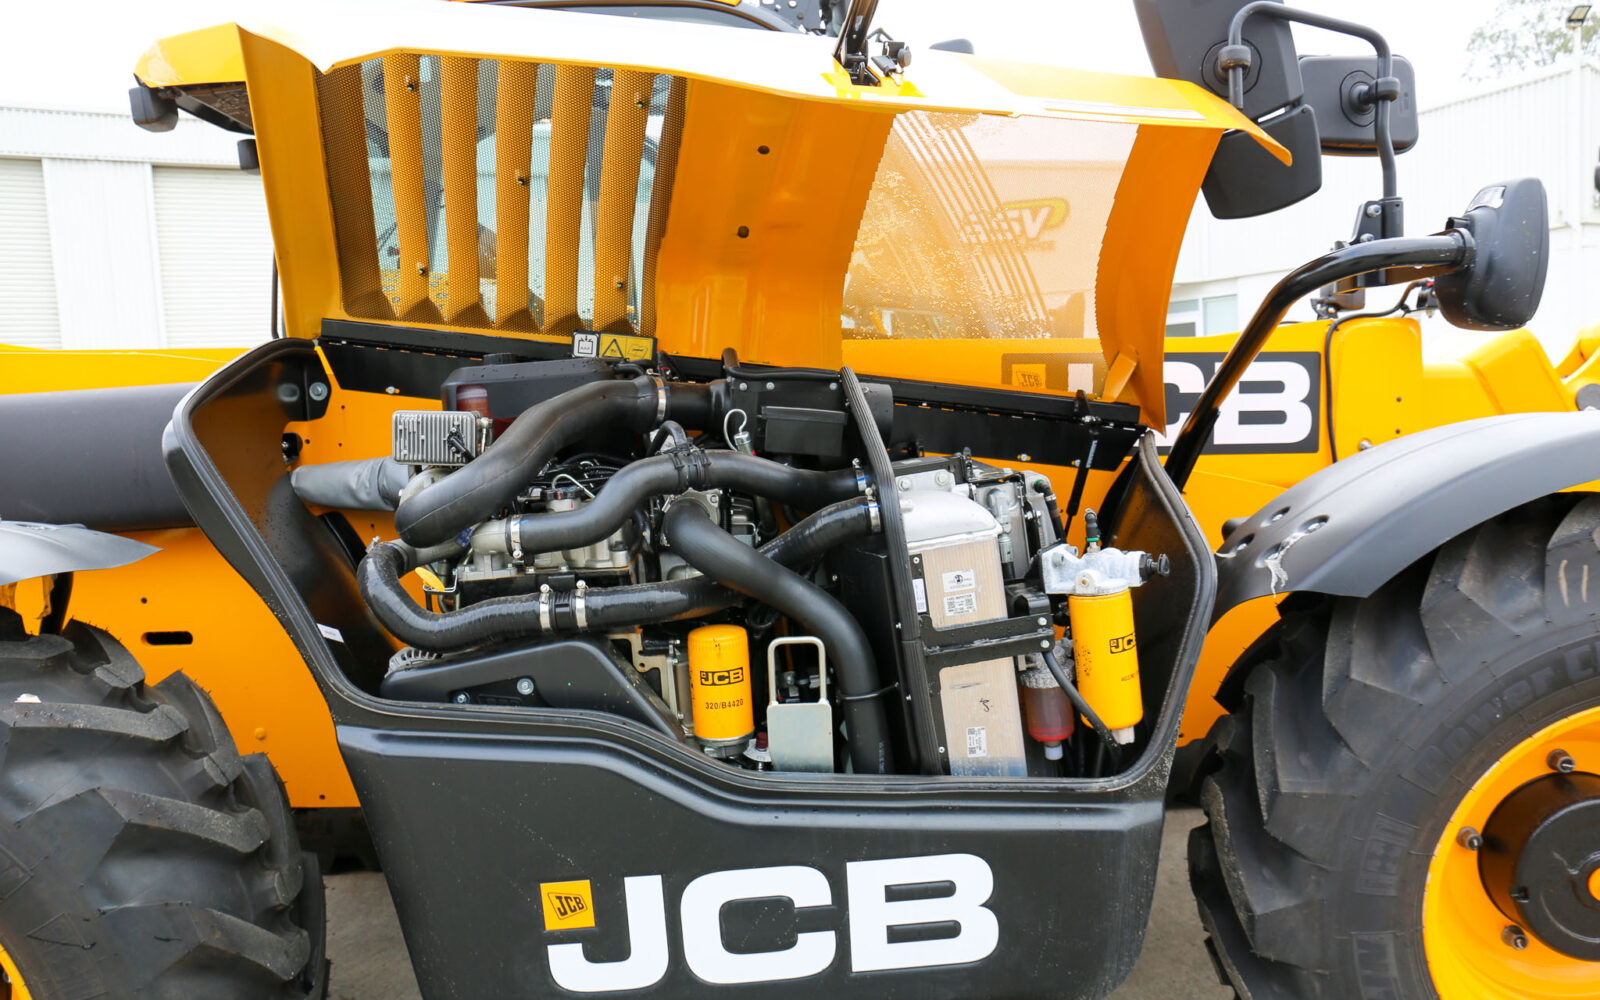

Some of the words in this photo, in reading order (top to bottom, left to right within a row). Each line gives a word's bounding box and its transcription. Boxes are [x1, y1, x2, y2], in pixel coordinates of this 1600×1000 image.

[701, 667, 744, 686] JCB
[705, 698, 744, 710] 320/B4420
[555, 895, 585, 917] JCB
[547, 853, 999, 992] JCB
